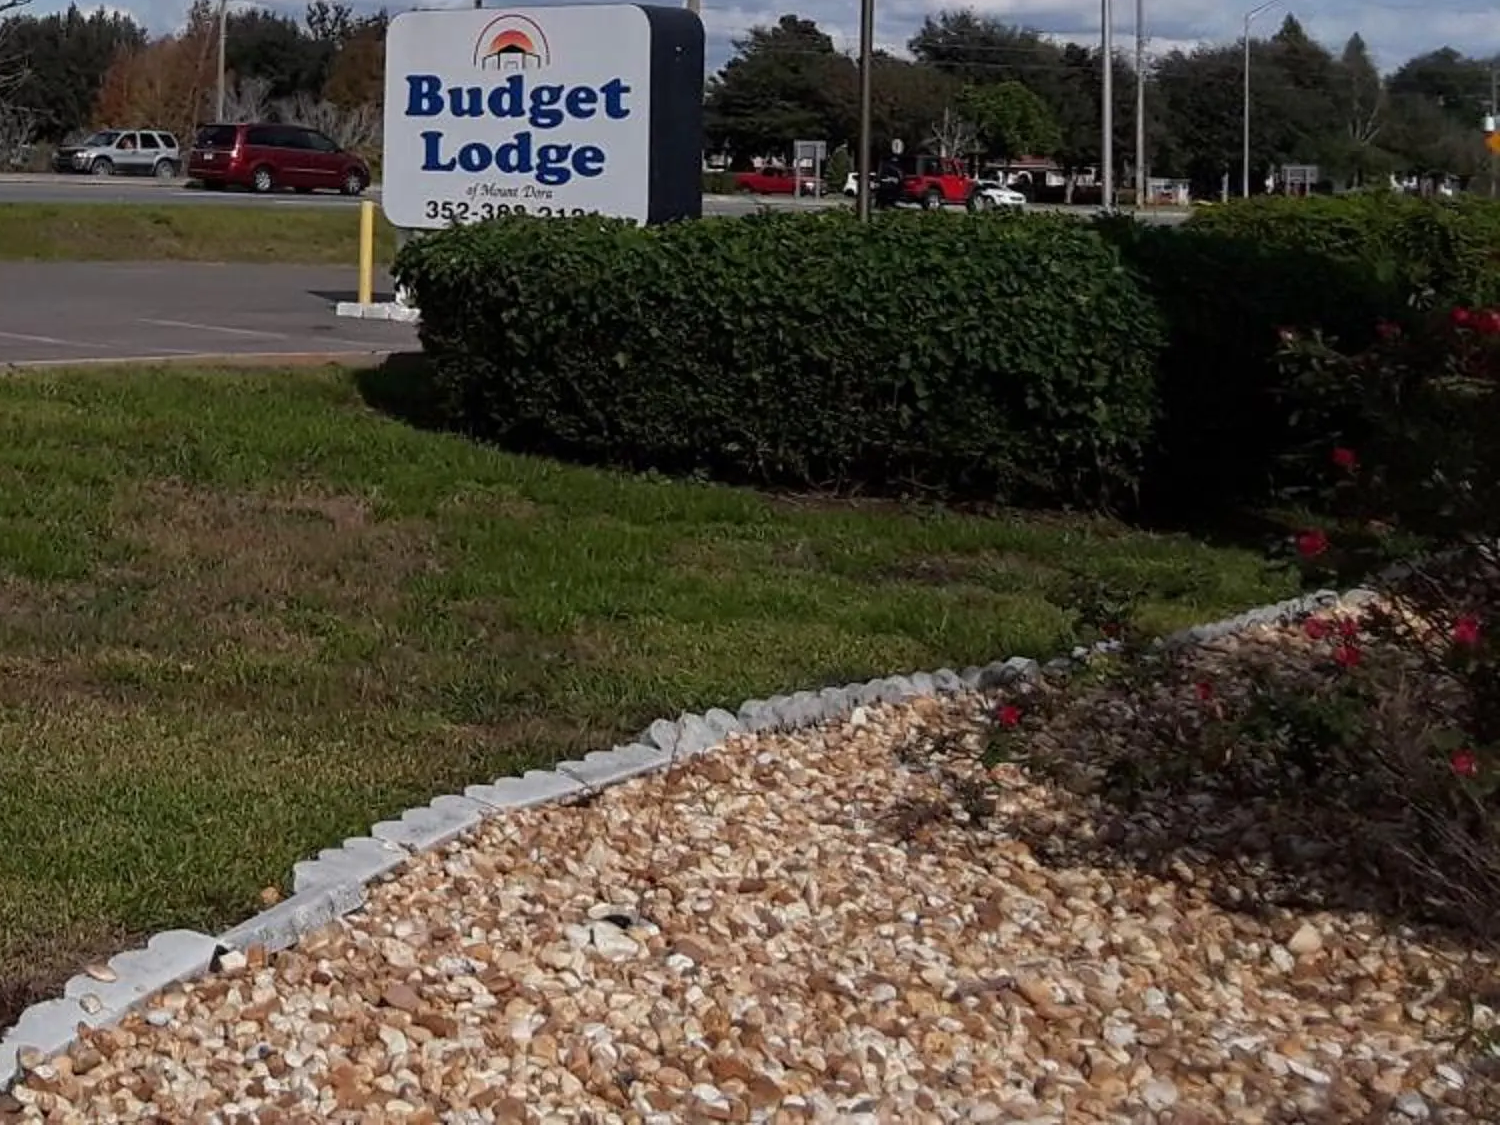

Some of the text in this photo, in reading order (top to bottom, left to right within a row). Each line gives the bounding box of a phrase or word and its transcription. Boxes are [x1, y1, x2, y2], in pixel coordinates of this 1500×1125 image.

[405, 74, 631, 129] Budget
[421, 131, 605, 186] Lodge
[466, 183, 554, 200] of Mount Dora
